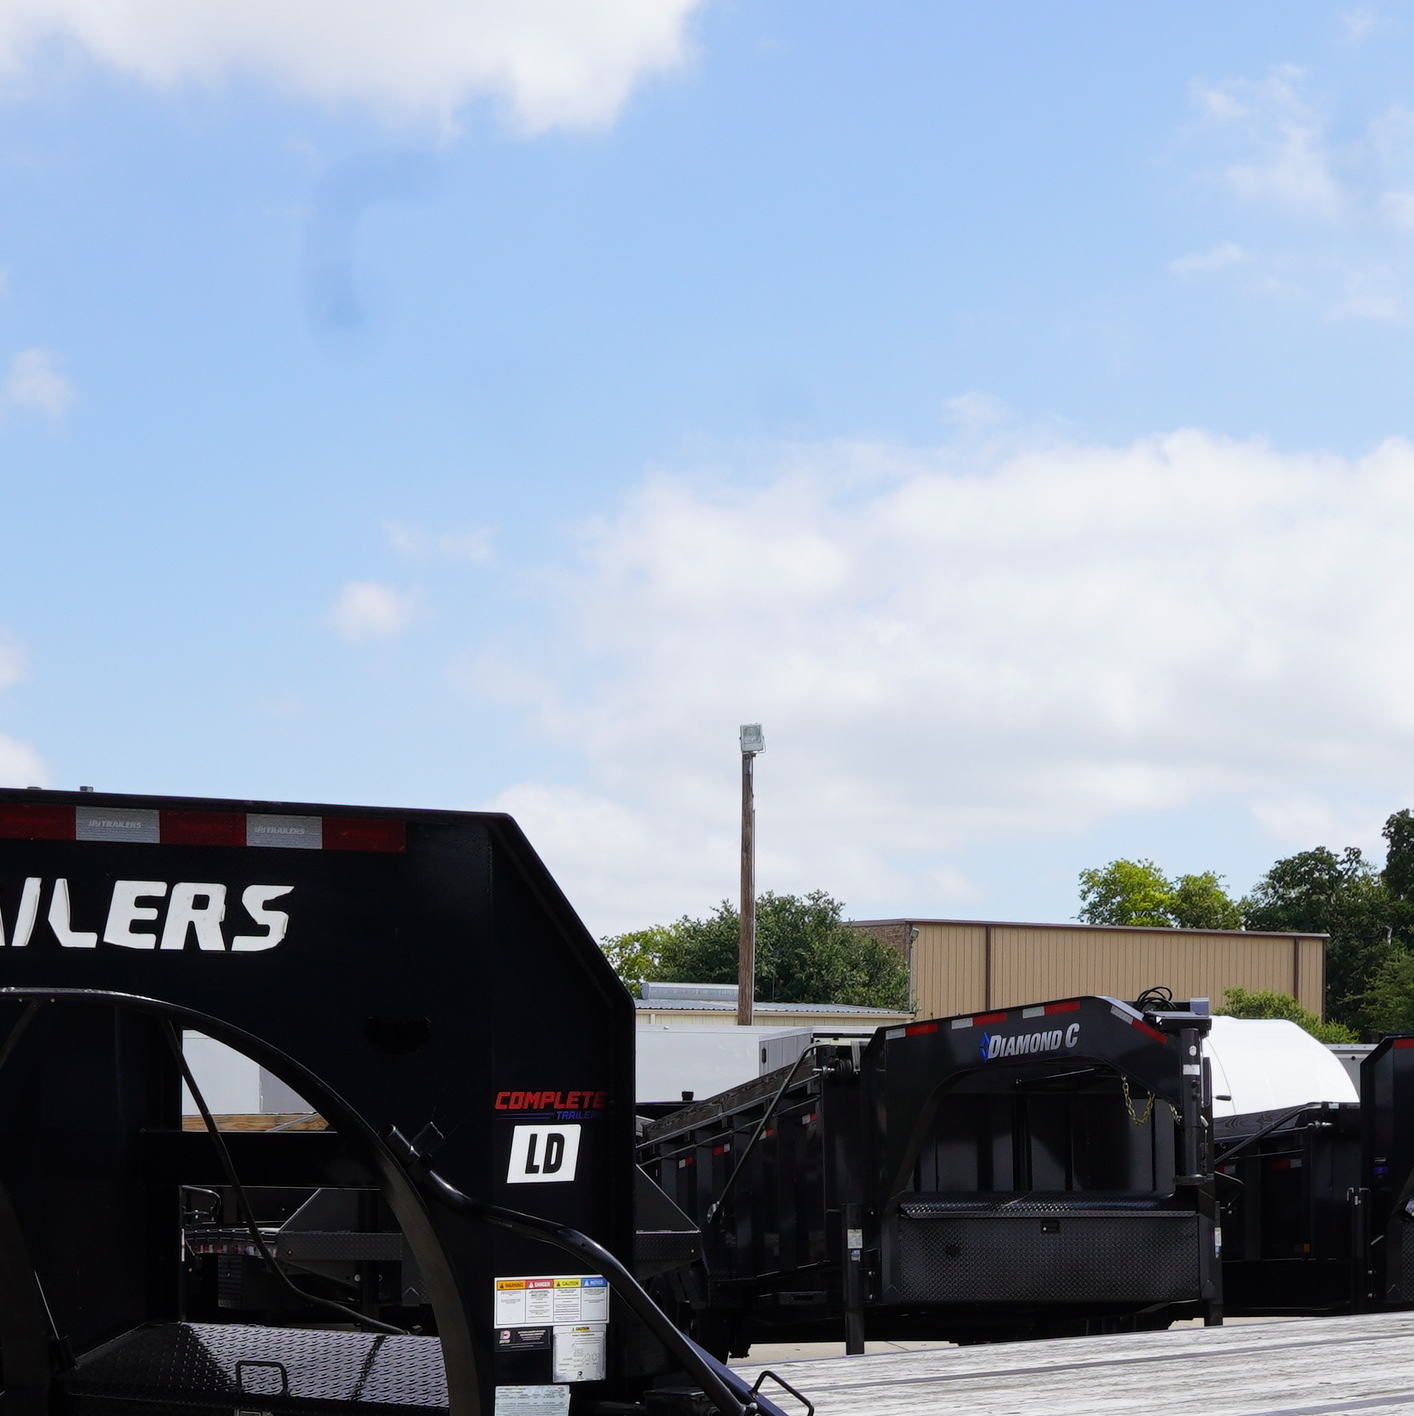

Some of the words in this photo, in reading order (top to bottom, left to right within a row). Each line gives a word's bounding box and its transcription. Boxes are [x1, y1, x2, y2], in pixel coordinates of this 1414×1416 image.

[988, 1029, 1063, 1059] DIAMOND
[1065, 1022, 1081, 1049] C
[494, 1091, 608, 1110] COMPLETE
[525, 1132, 566, 1175] LD
